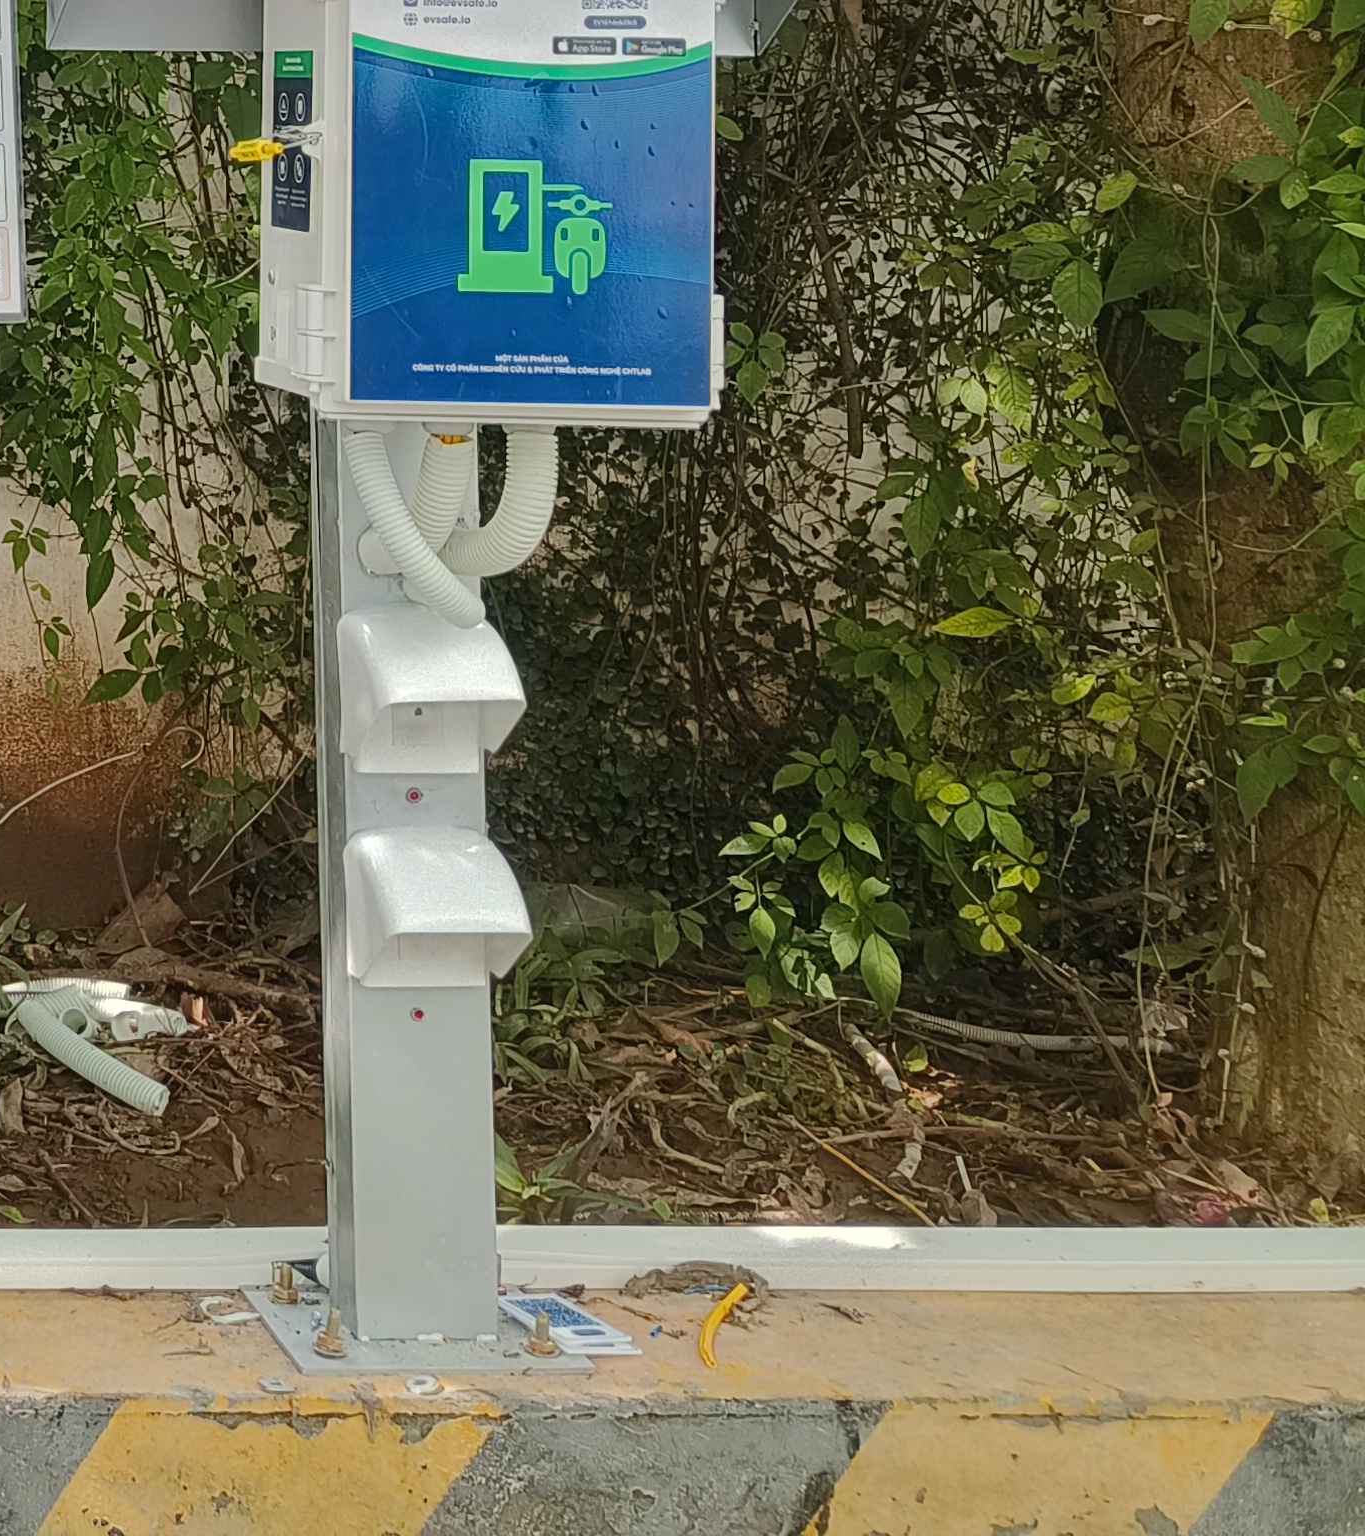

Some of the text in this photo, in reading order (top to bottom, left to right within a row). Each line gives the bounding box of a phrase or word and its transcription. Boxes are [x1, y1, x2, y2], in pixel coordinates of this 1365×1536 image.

[423, 15, 471, 25] evsafe.io
[572, 44, 612, 54] App Store
[435, 364, 445, 372] TY
